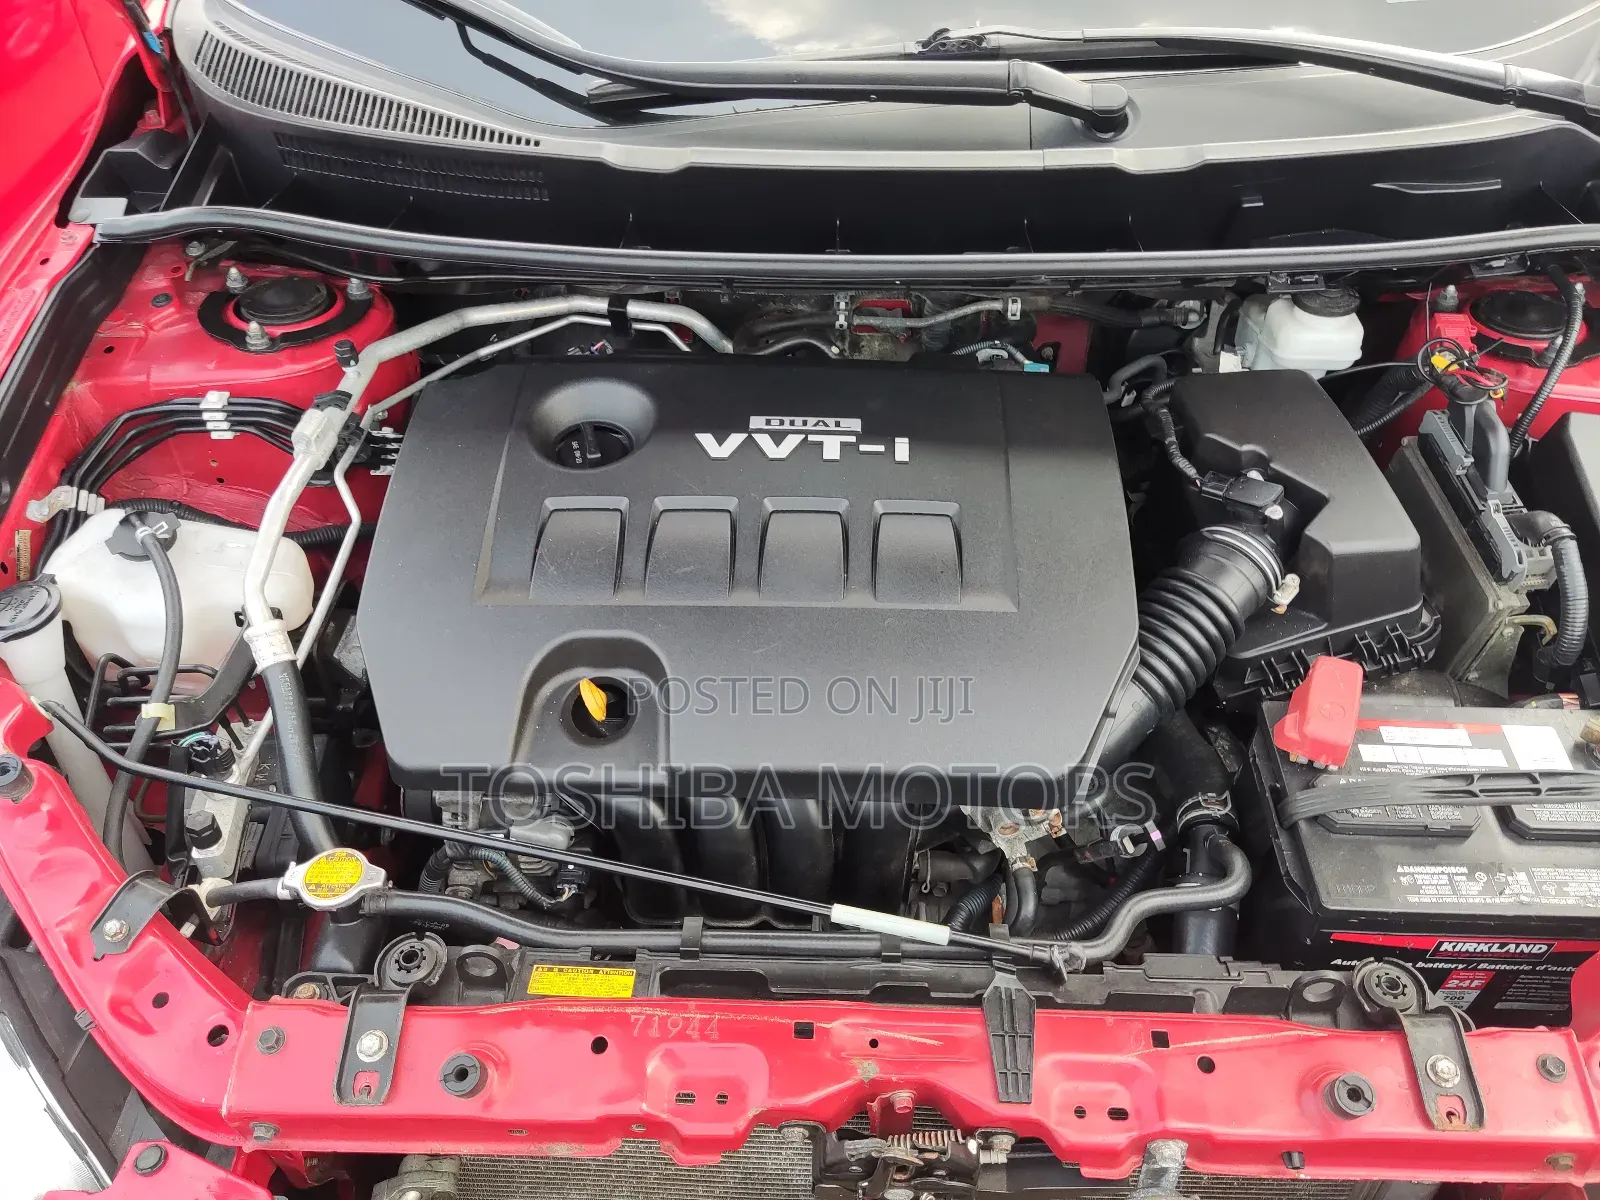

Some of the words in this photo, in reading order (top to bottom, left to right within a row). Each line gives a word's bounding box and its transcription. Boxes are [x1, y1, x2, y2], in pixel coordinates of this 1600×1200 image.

[765, 418, 851, 429] DUAL
[1439, 941, 1549, 954] KIRKLAND
[1416, 961, 1467, 970] battery
[1477, 962, 1533, 971] Batterie
[1445, 979, 1486, 988] 24F
[630, 1013, 720, 1040] 71944
